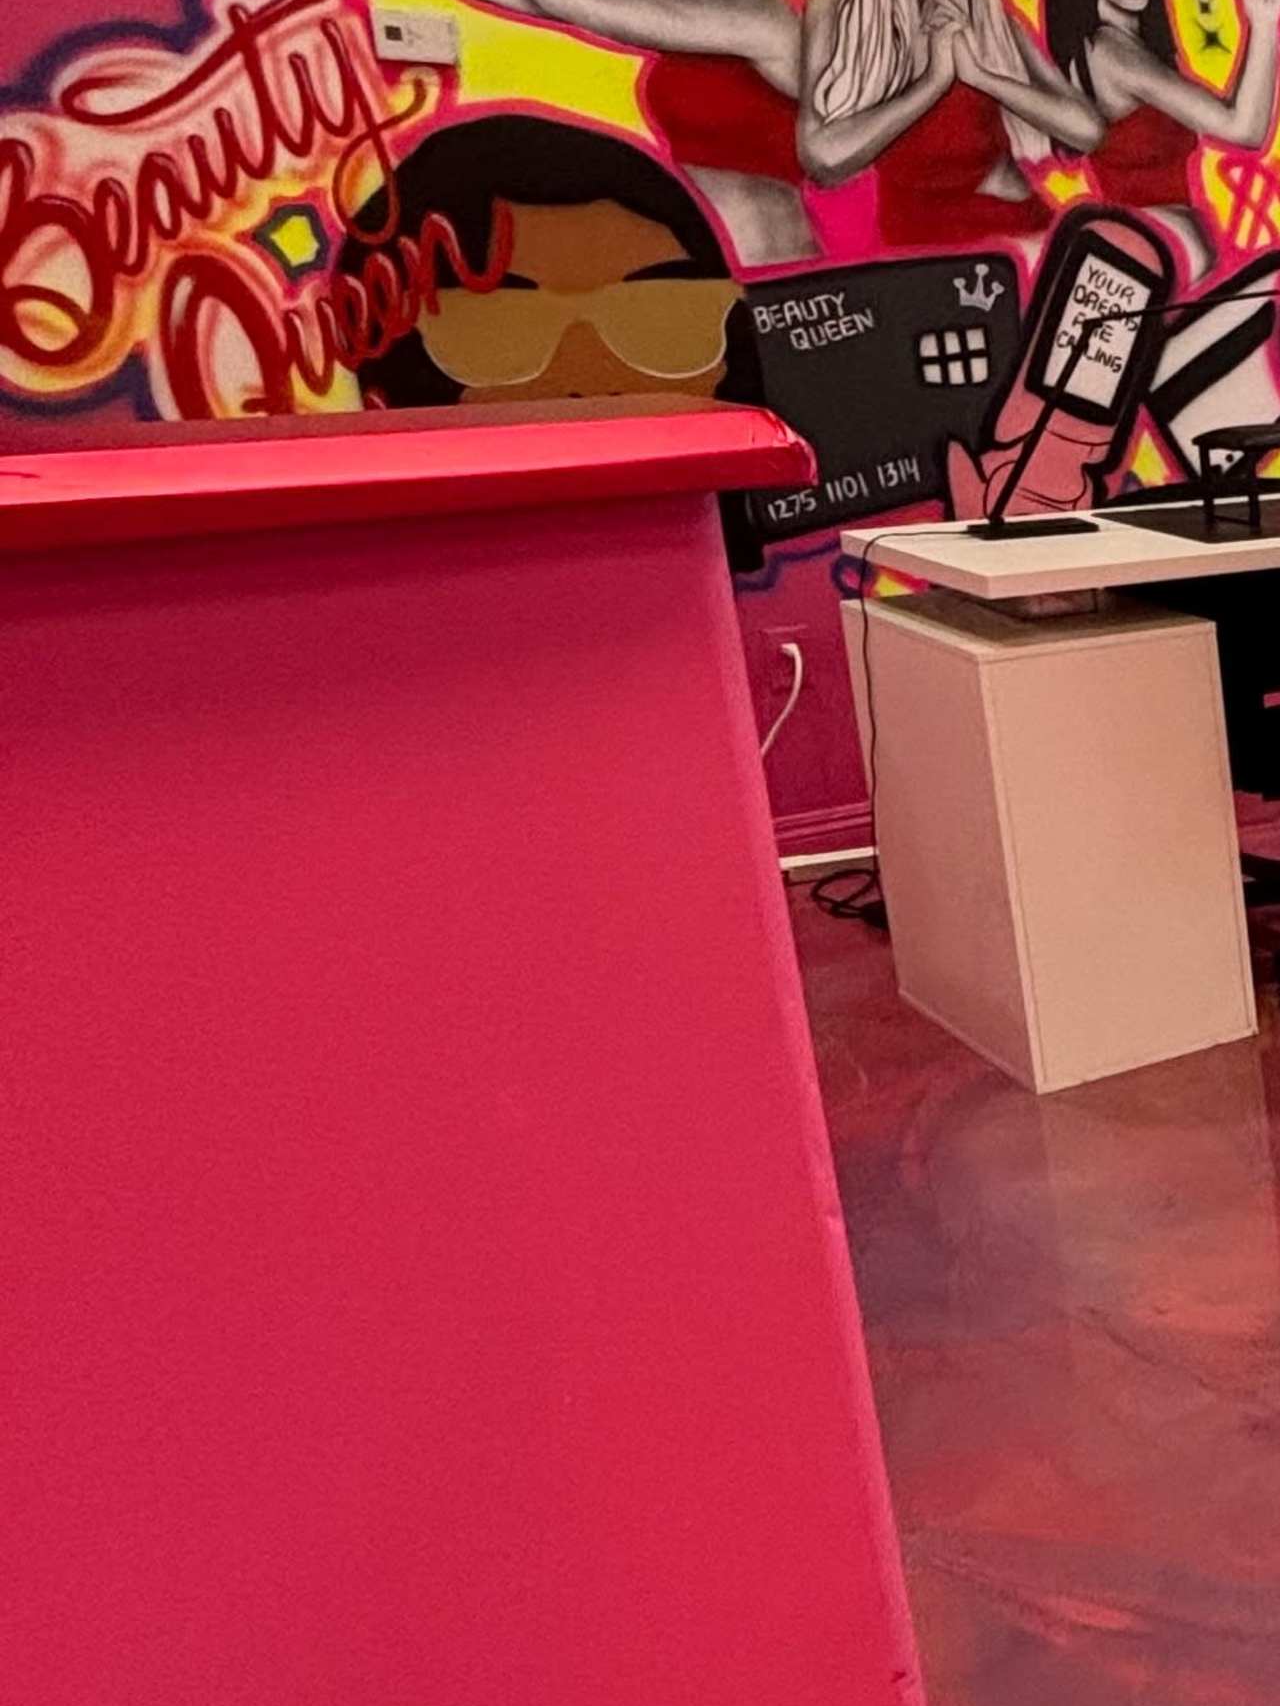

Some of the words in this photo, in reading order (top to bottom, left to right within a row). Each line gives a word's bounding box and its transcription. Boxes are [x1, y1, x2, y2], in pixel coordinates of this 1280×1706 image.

[1088, 264, 1135, 305] YOUR
[752, 291, 846, 335] BEAUTY
[789, 307, 875, 350] QUEEN
[1072, 311, 1115, 344] AE
[1073, 284, 1139, 332] DREAS
[767, 488, 818, 523] 1275
[824, 471, 870, 505] 1101
[876, 455, 921, 489] 1314
